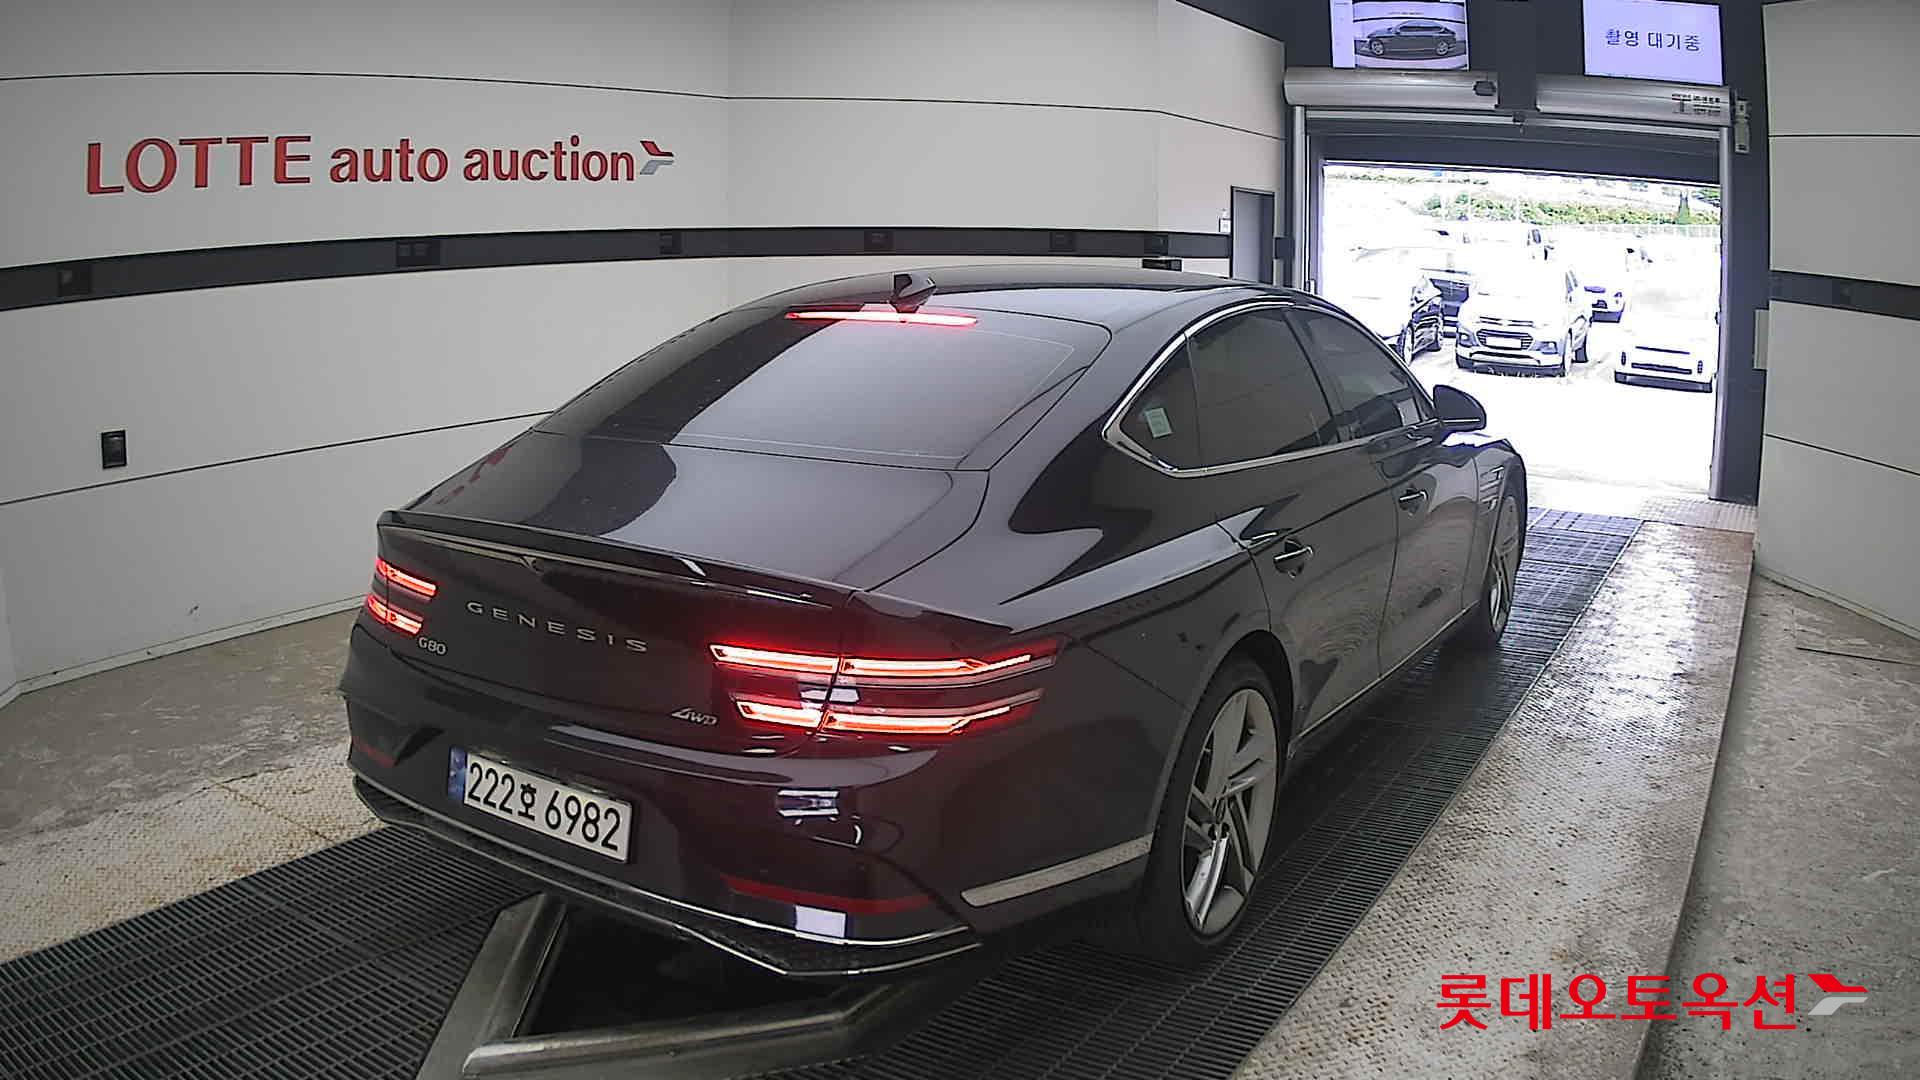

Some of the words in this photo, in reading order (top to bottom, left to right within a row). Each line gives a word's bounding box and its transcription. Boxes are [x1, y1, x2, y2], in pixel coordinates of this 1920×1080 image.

[1647, 32, 1701, 52] 대기중
[86, 135, 312, 194] LOTTE
[329, 138, 448, 183] auto
[463, 135, 635, 183] auction
[418, 635, 448, 656] G80
[466, 600, 649, 654] GENESIS
[671, 707, 719, 728] 4WD
[466, 761, 537, 821] 222호
[544, 789, 623, 852] 6982
